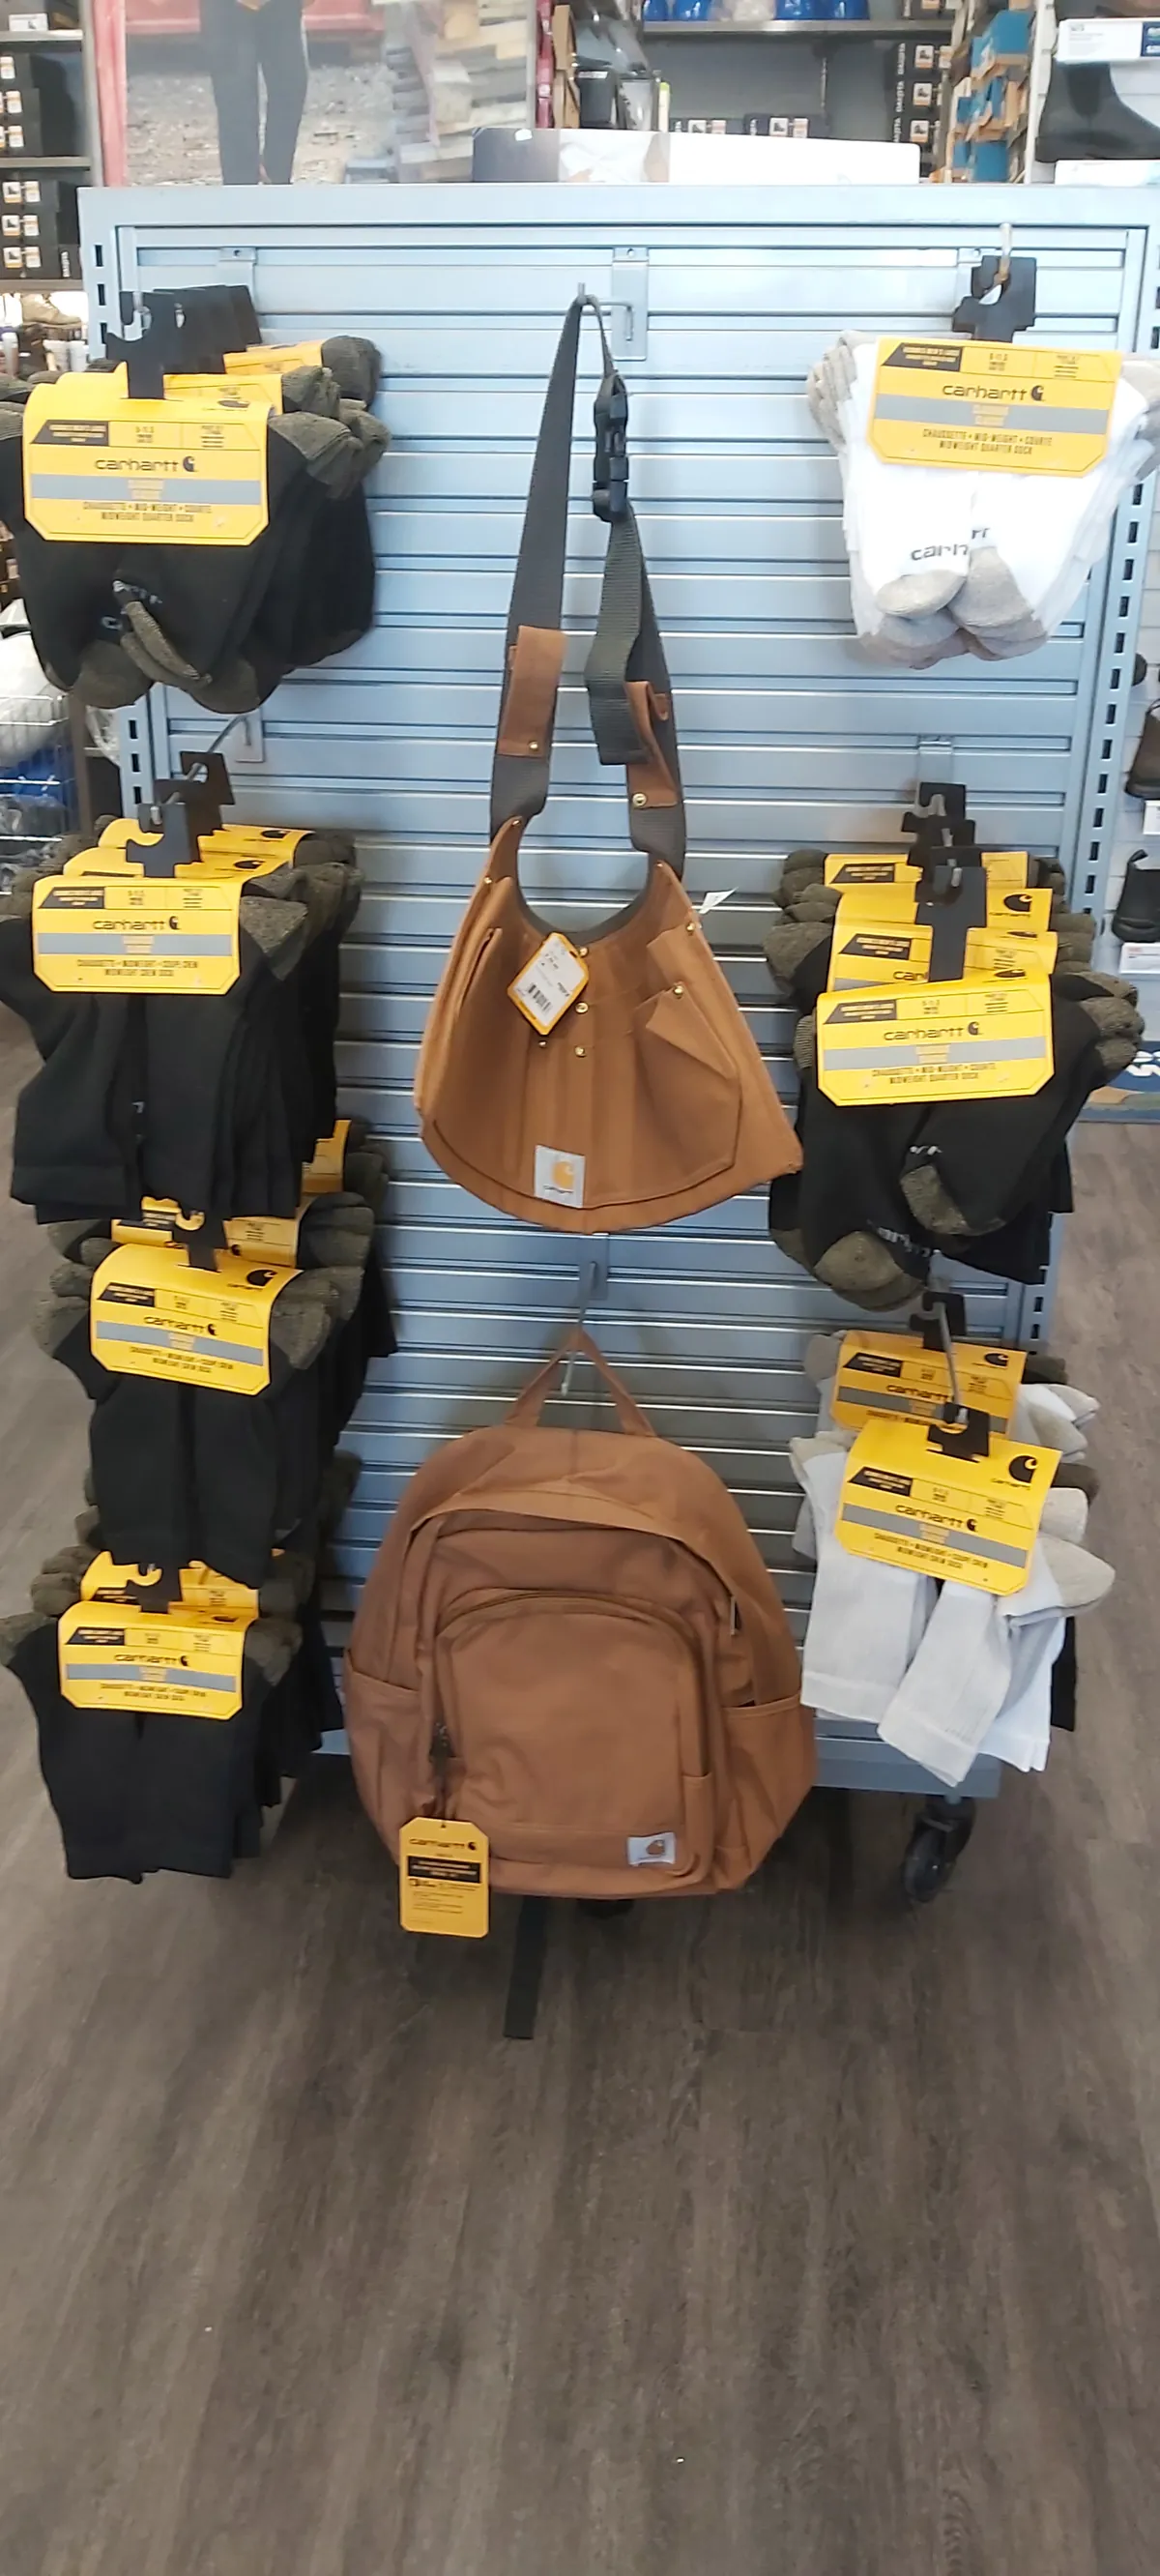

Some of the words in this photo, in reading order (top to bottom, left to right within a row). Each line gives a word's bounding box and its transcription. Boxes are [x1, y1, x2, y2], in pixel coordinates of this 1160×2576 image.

[942, 385, 1028, 401] carhartt
[95, 459, 179, 472] carhartt
[93, 920, 165, 931] carhartt
[884, 1026, 965, 1041] carhartt
[895, 1505, 964, 1528] carhartt
